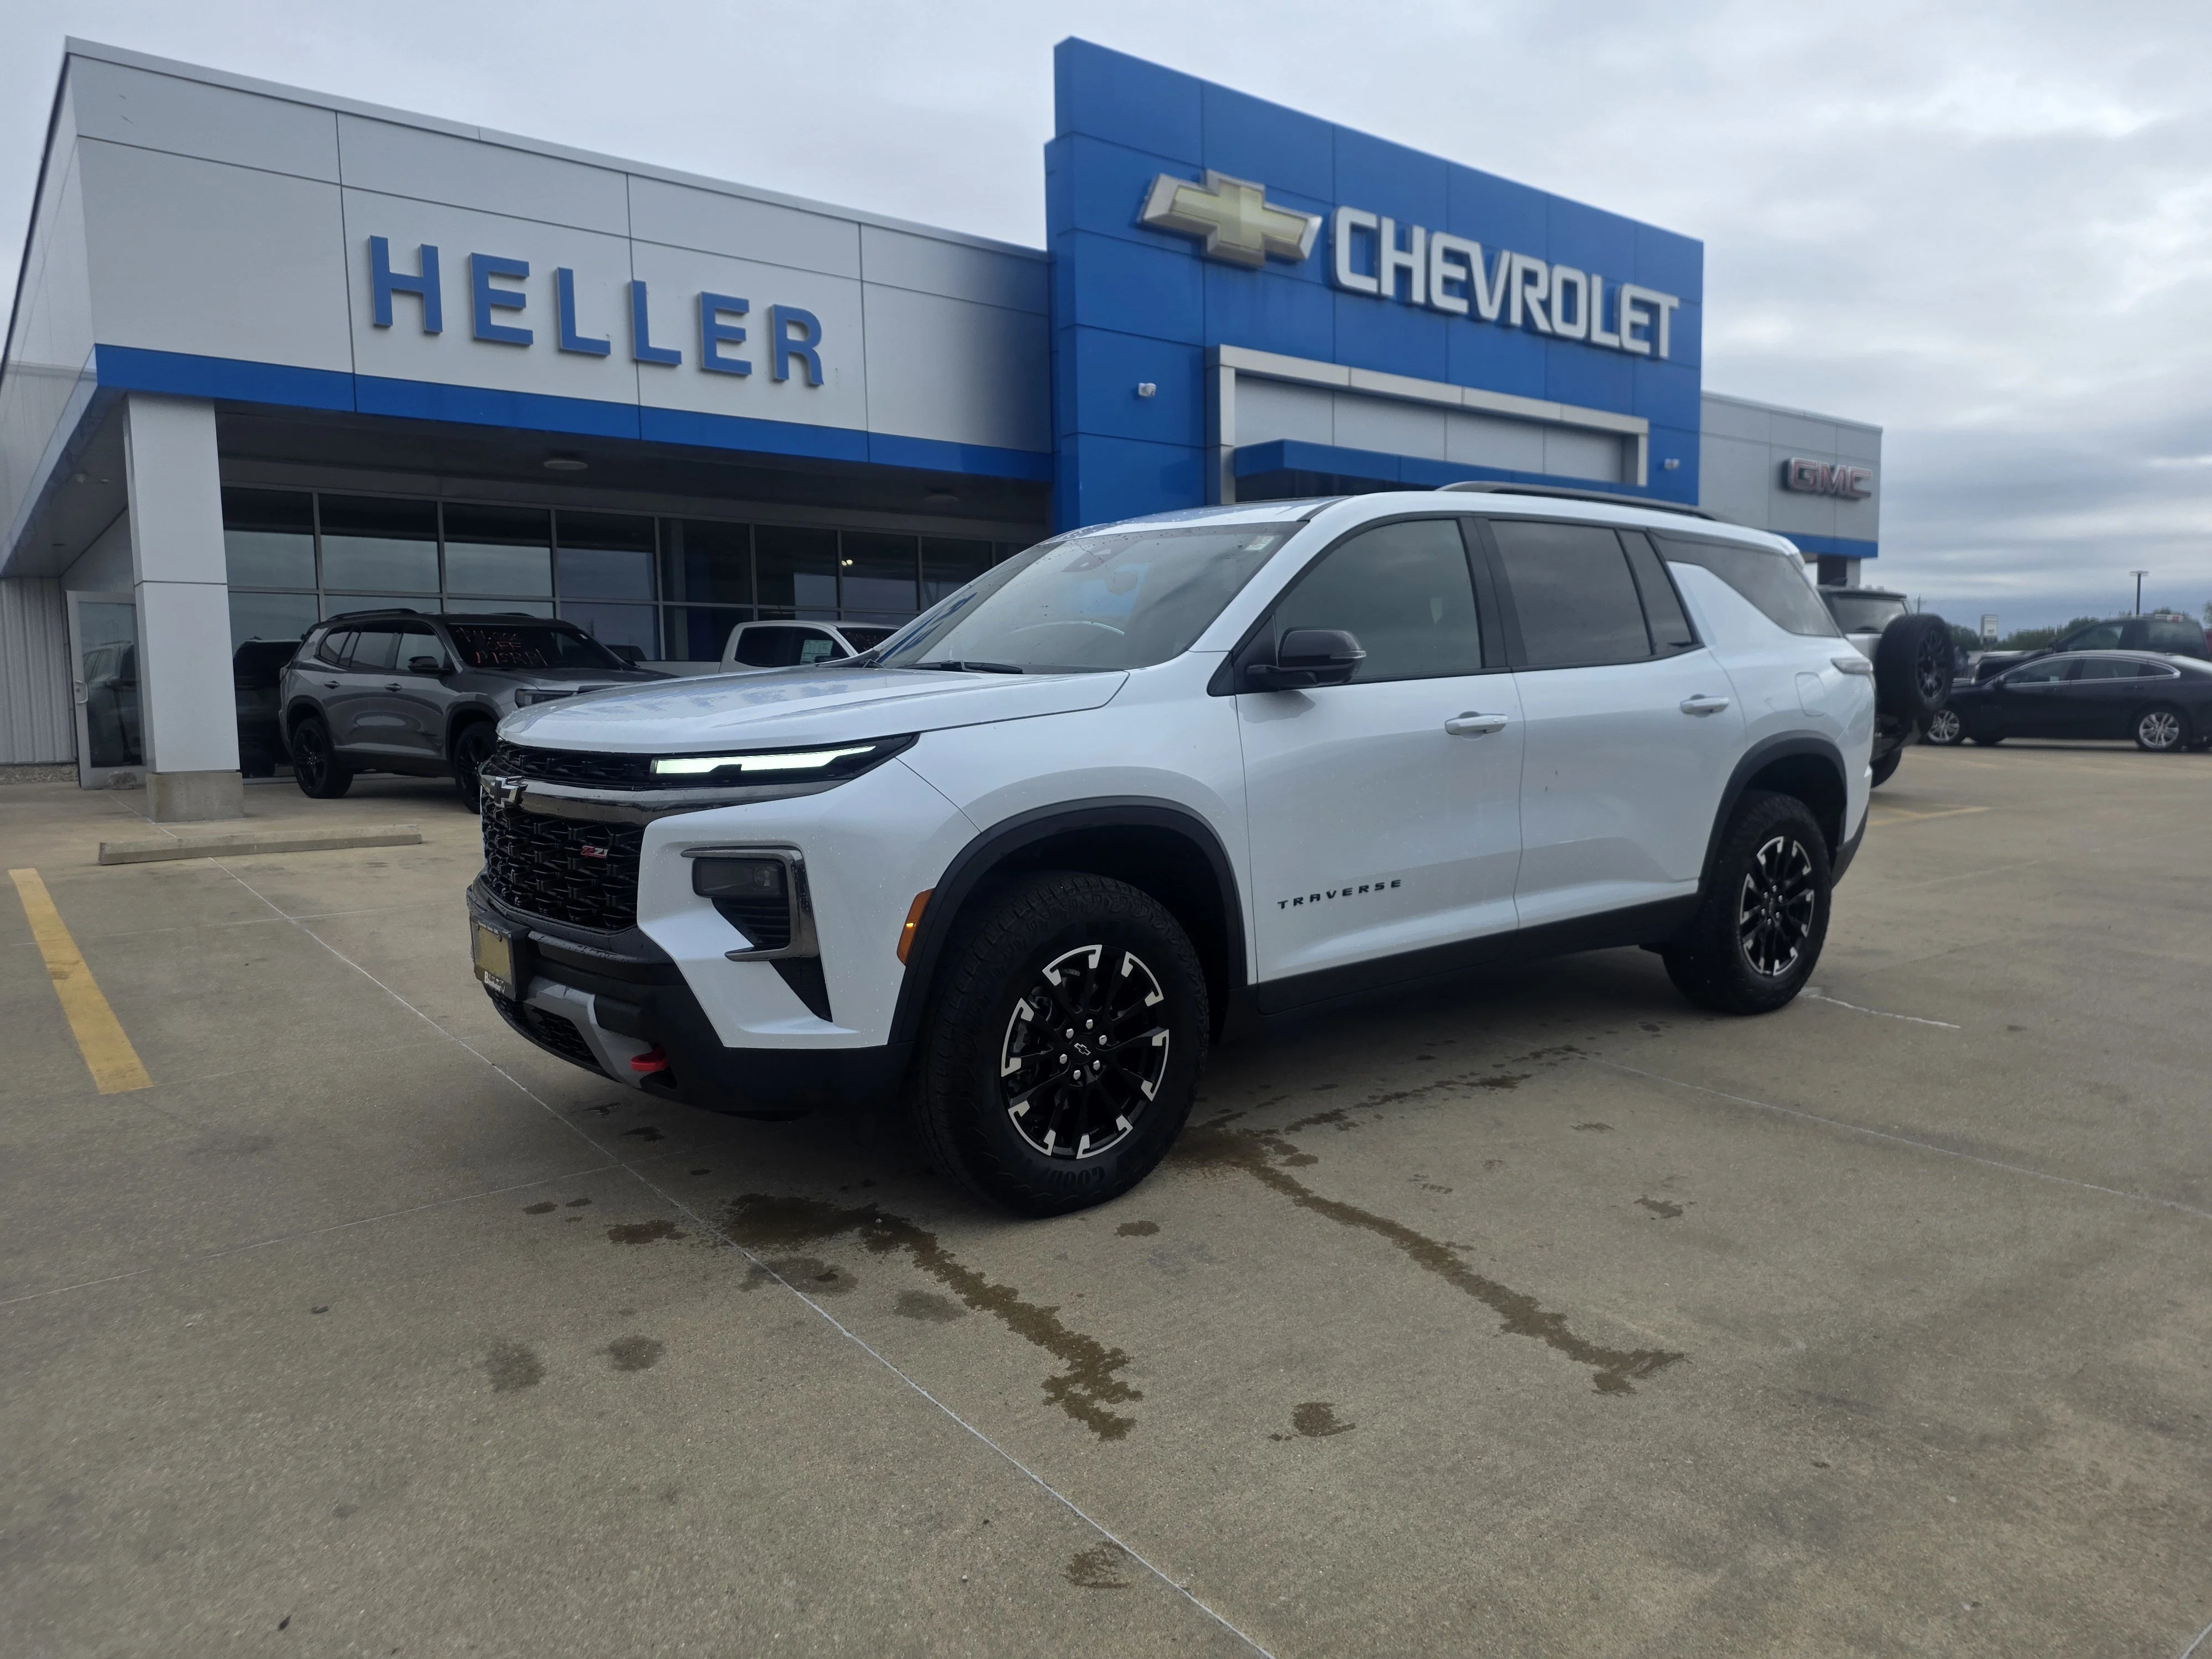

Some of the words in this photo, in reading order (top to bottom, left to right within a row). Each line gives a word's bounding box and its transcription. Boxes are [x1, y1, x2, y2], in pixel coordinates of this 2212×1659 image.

[1334, 205, 1679, 359] CHEVROLET
[369, 234, 824, 385] HELLER
[1791, 457, 1872, 498] GMC
[486, 641, 521, 650] OFF
[580, 845, 609, 858] Z71
[1277, 879, 1402, 909] TRAVERSE
